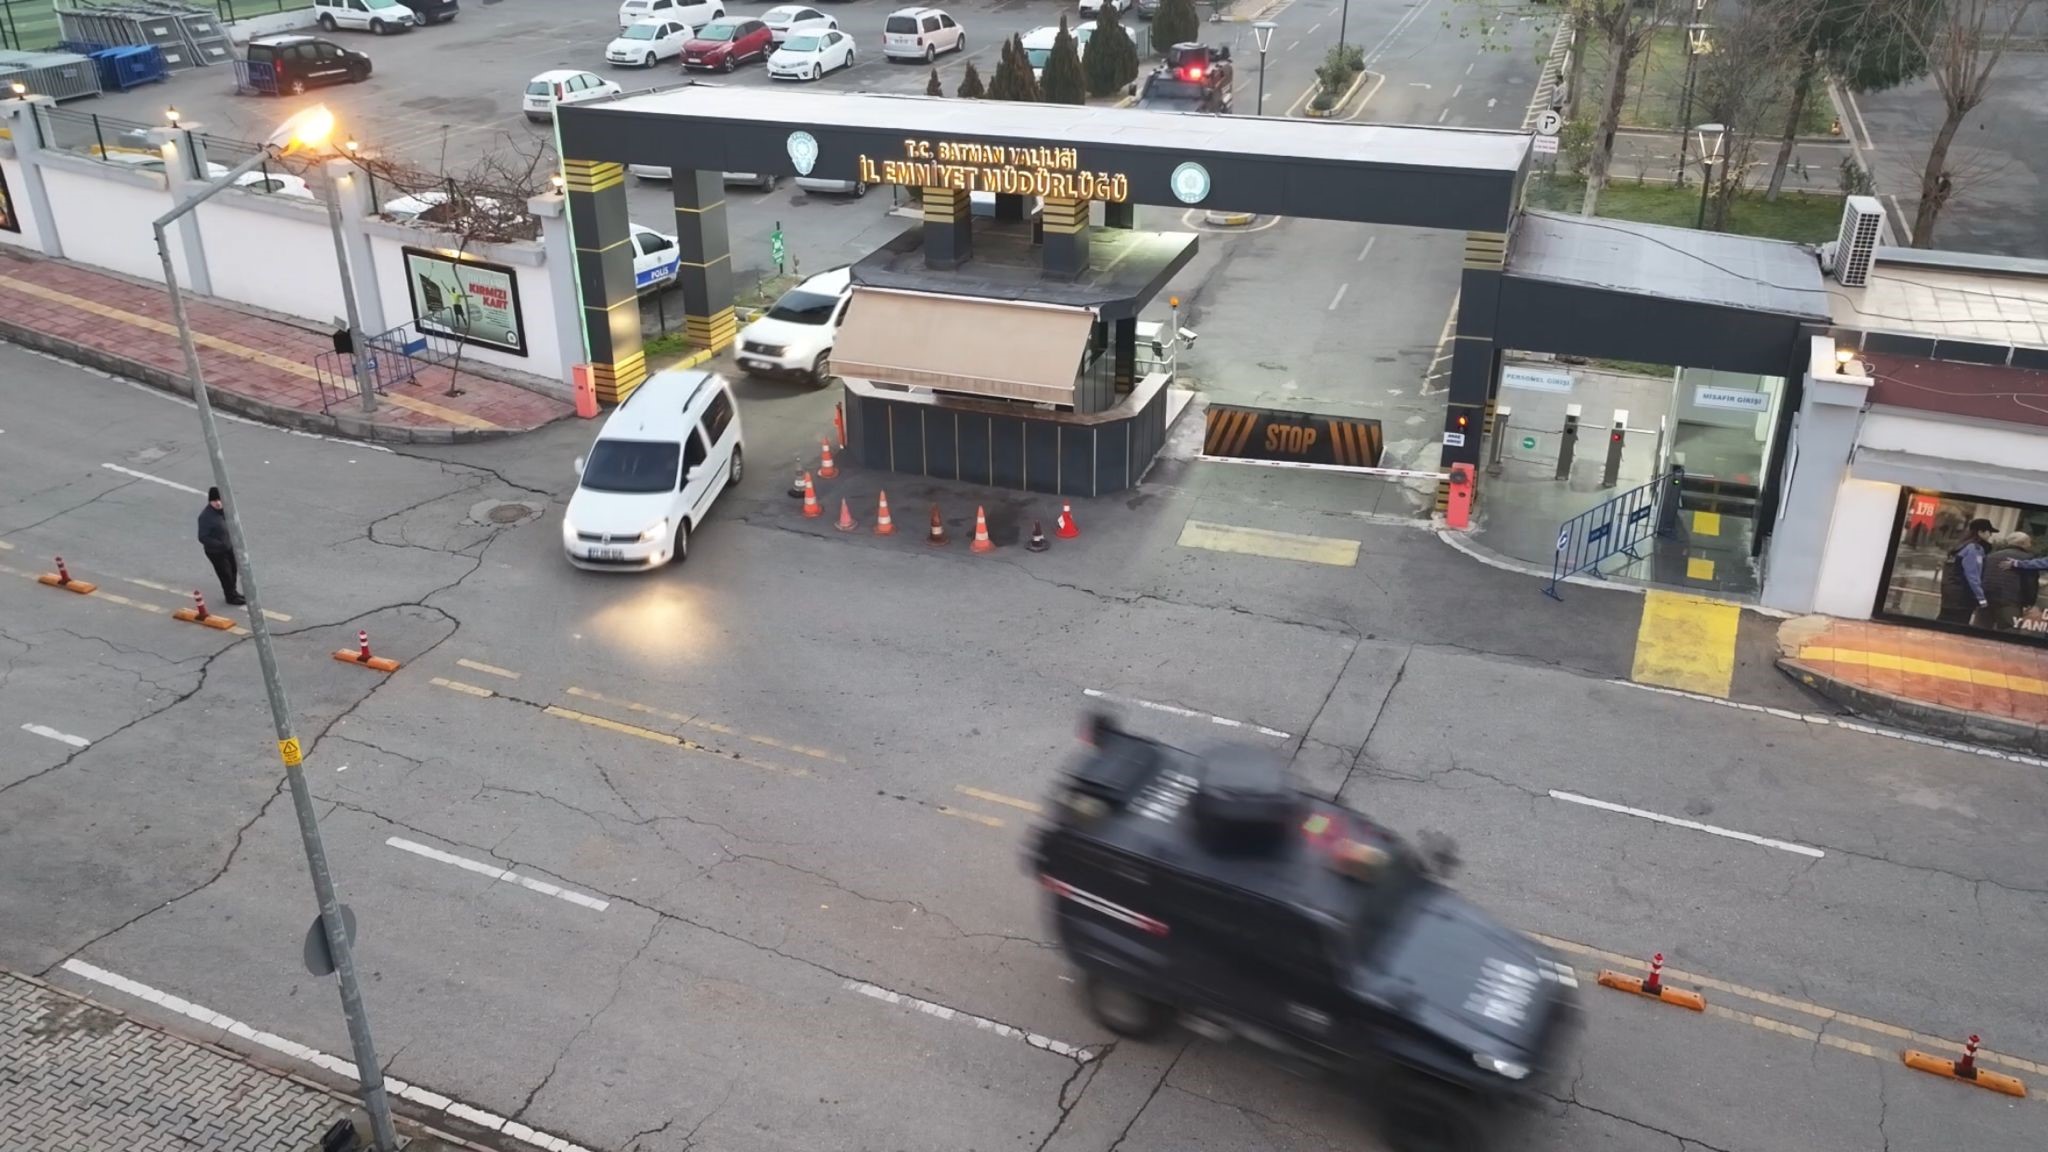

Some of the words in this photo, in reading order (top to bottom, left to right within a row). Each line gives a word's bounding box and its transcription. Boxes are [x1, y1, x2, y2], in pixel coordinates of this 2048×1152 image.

[904, 139, 934, 159] T.C.
[938, 142, 1005, 164] BATMAN
[1008, 145, 1078, 170] VALİLİĞİ
[859, 154, 881, 183] İL
[883, 160, 978, 190] EMNİYET
[982, 165, 1128, 203] MÜDÜRLÜĞÜ
[483, 297, 509, 310] KART
[1506, 373, 1544, 383] PERSONEL
[1265, 423, 1317, 455] STOP
[2012, 616, 2048, 634] YANI
